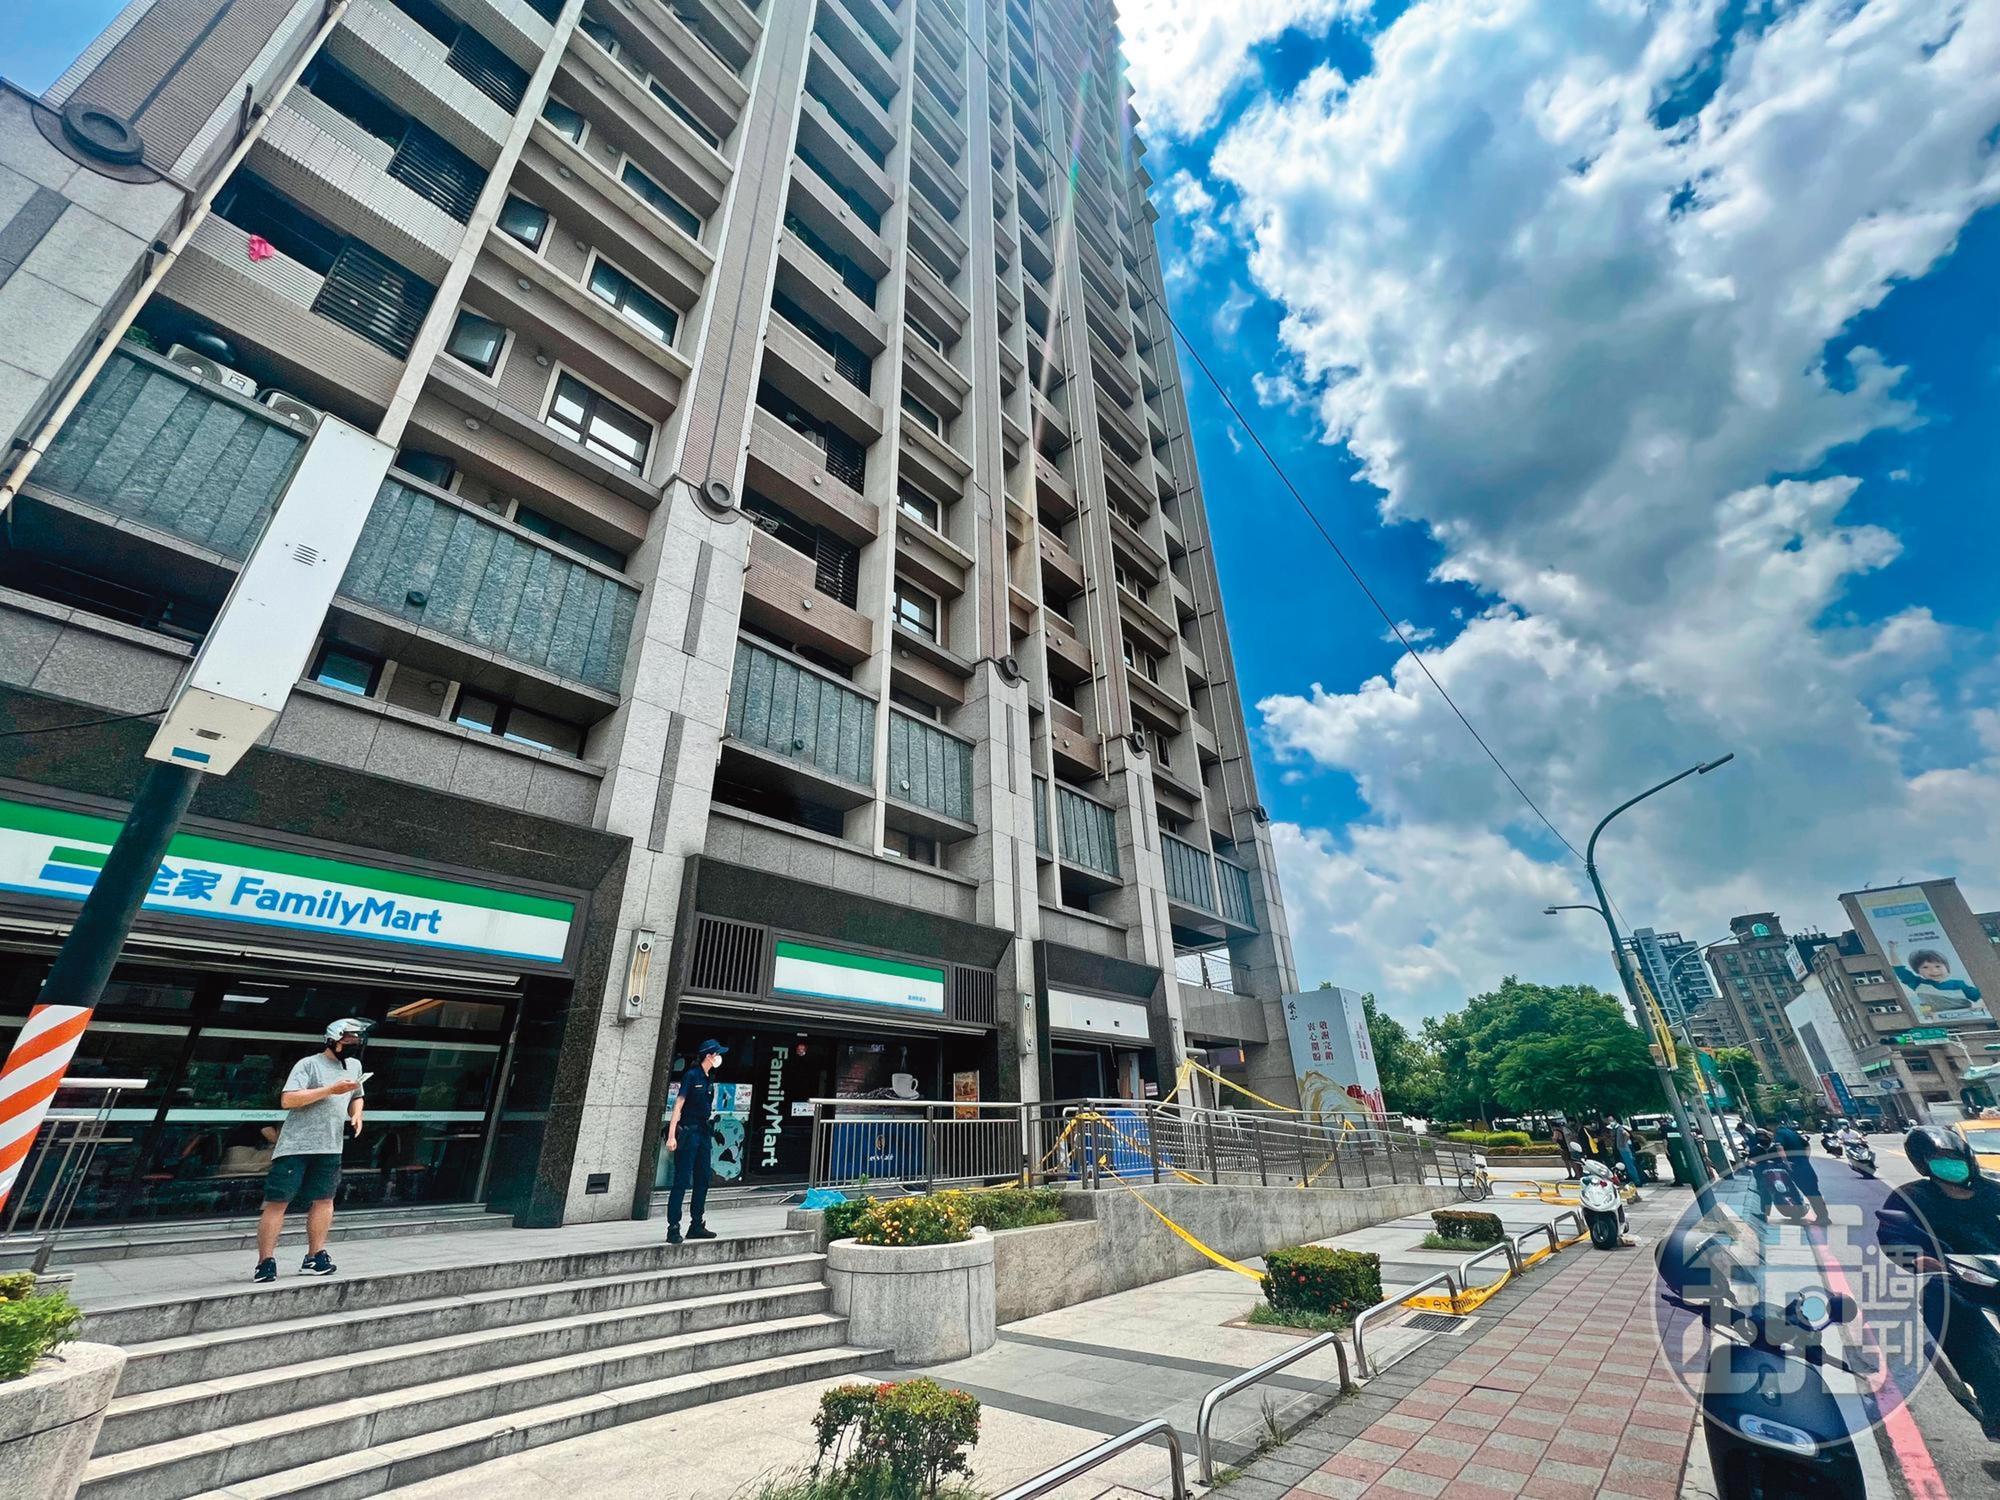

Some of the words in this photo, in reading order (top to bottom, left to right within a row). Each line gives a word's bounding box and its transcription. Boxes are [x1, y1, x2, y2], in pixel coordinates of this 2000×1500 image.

[148, 864, 222, 901] 全家
[230, 876, 442, 934] FamilyMart
[761, 1046, 789, 1167] FamilyMart
